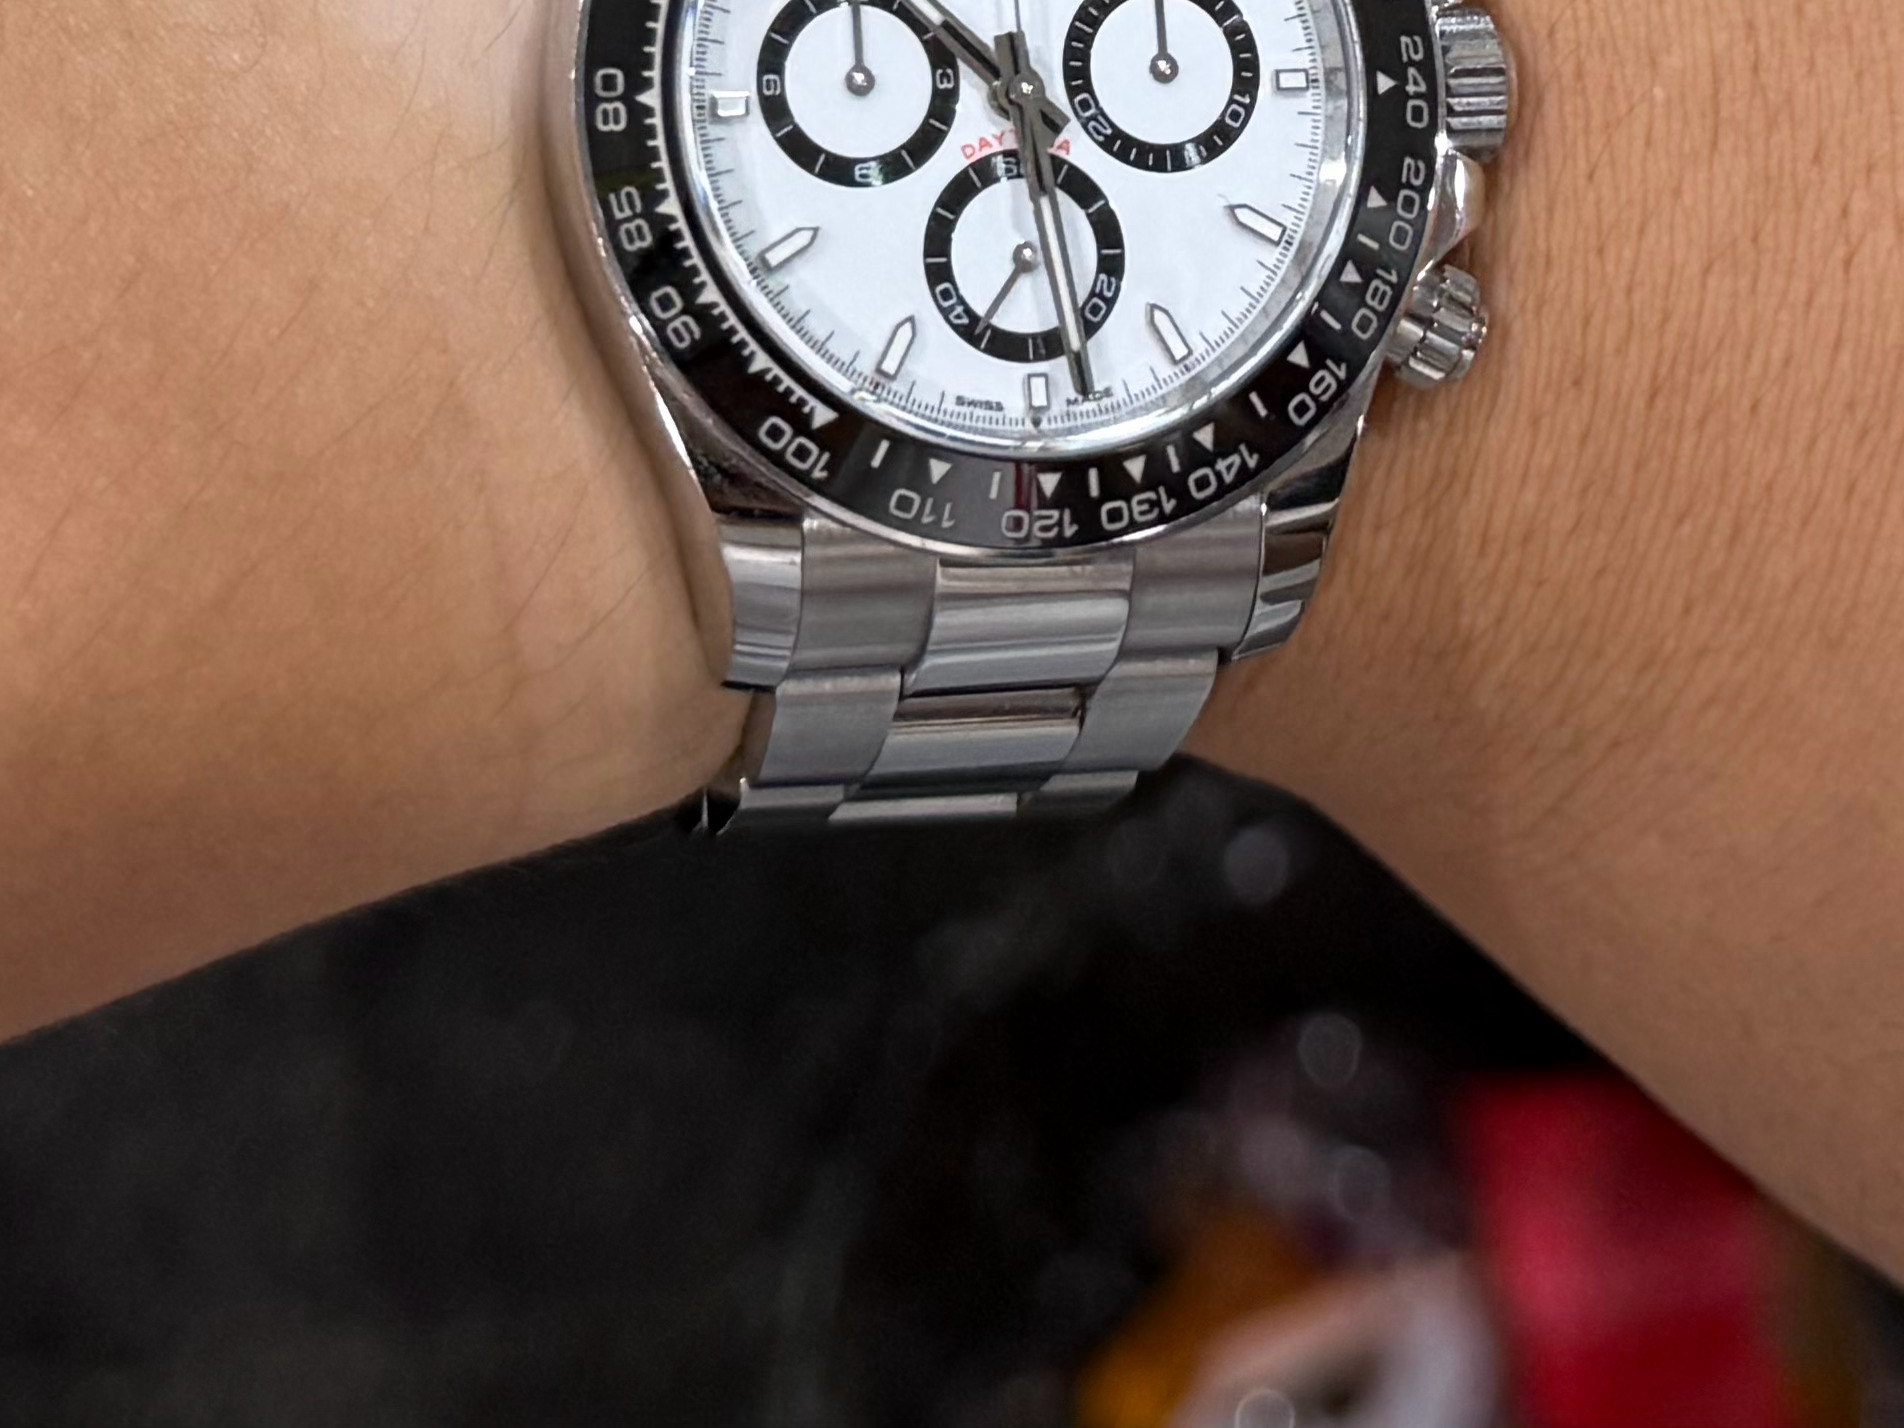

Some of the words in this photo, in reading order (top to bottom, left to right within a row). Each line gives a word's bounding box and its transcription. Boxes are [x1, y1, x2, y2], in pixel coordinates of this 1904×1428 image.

[594, 66, 628, 133] 80
[935, 67, 956, 90] 3
[1399, 35, 1430, 130] 240
[1072, 92, 1113, 142] 20
[1224, 93, 1251, 128] 10
[609, 185, 654, 252] 85
[1388, 155, 1427, 252] 200
[649, 284, 702, 349] 90
[934, 281, 970, 326] 40
[1083, 272, 1117, 323] 20
[1350, 267, 1400, 341] 180
[954, 394, 1004, 412] SWISS
[1287, 357, 1347, 427] 160
[757, 414, 832, 481] 100
[1187, 442, 1260, 501] 140
[888, 487, 957, 529] 110
[1001, 507, 1080, 540] 120
[1100, 484, 1178, 532] 130
